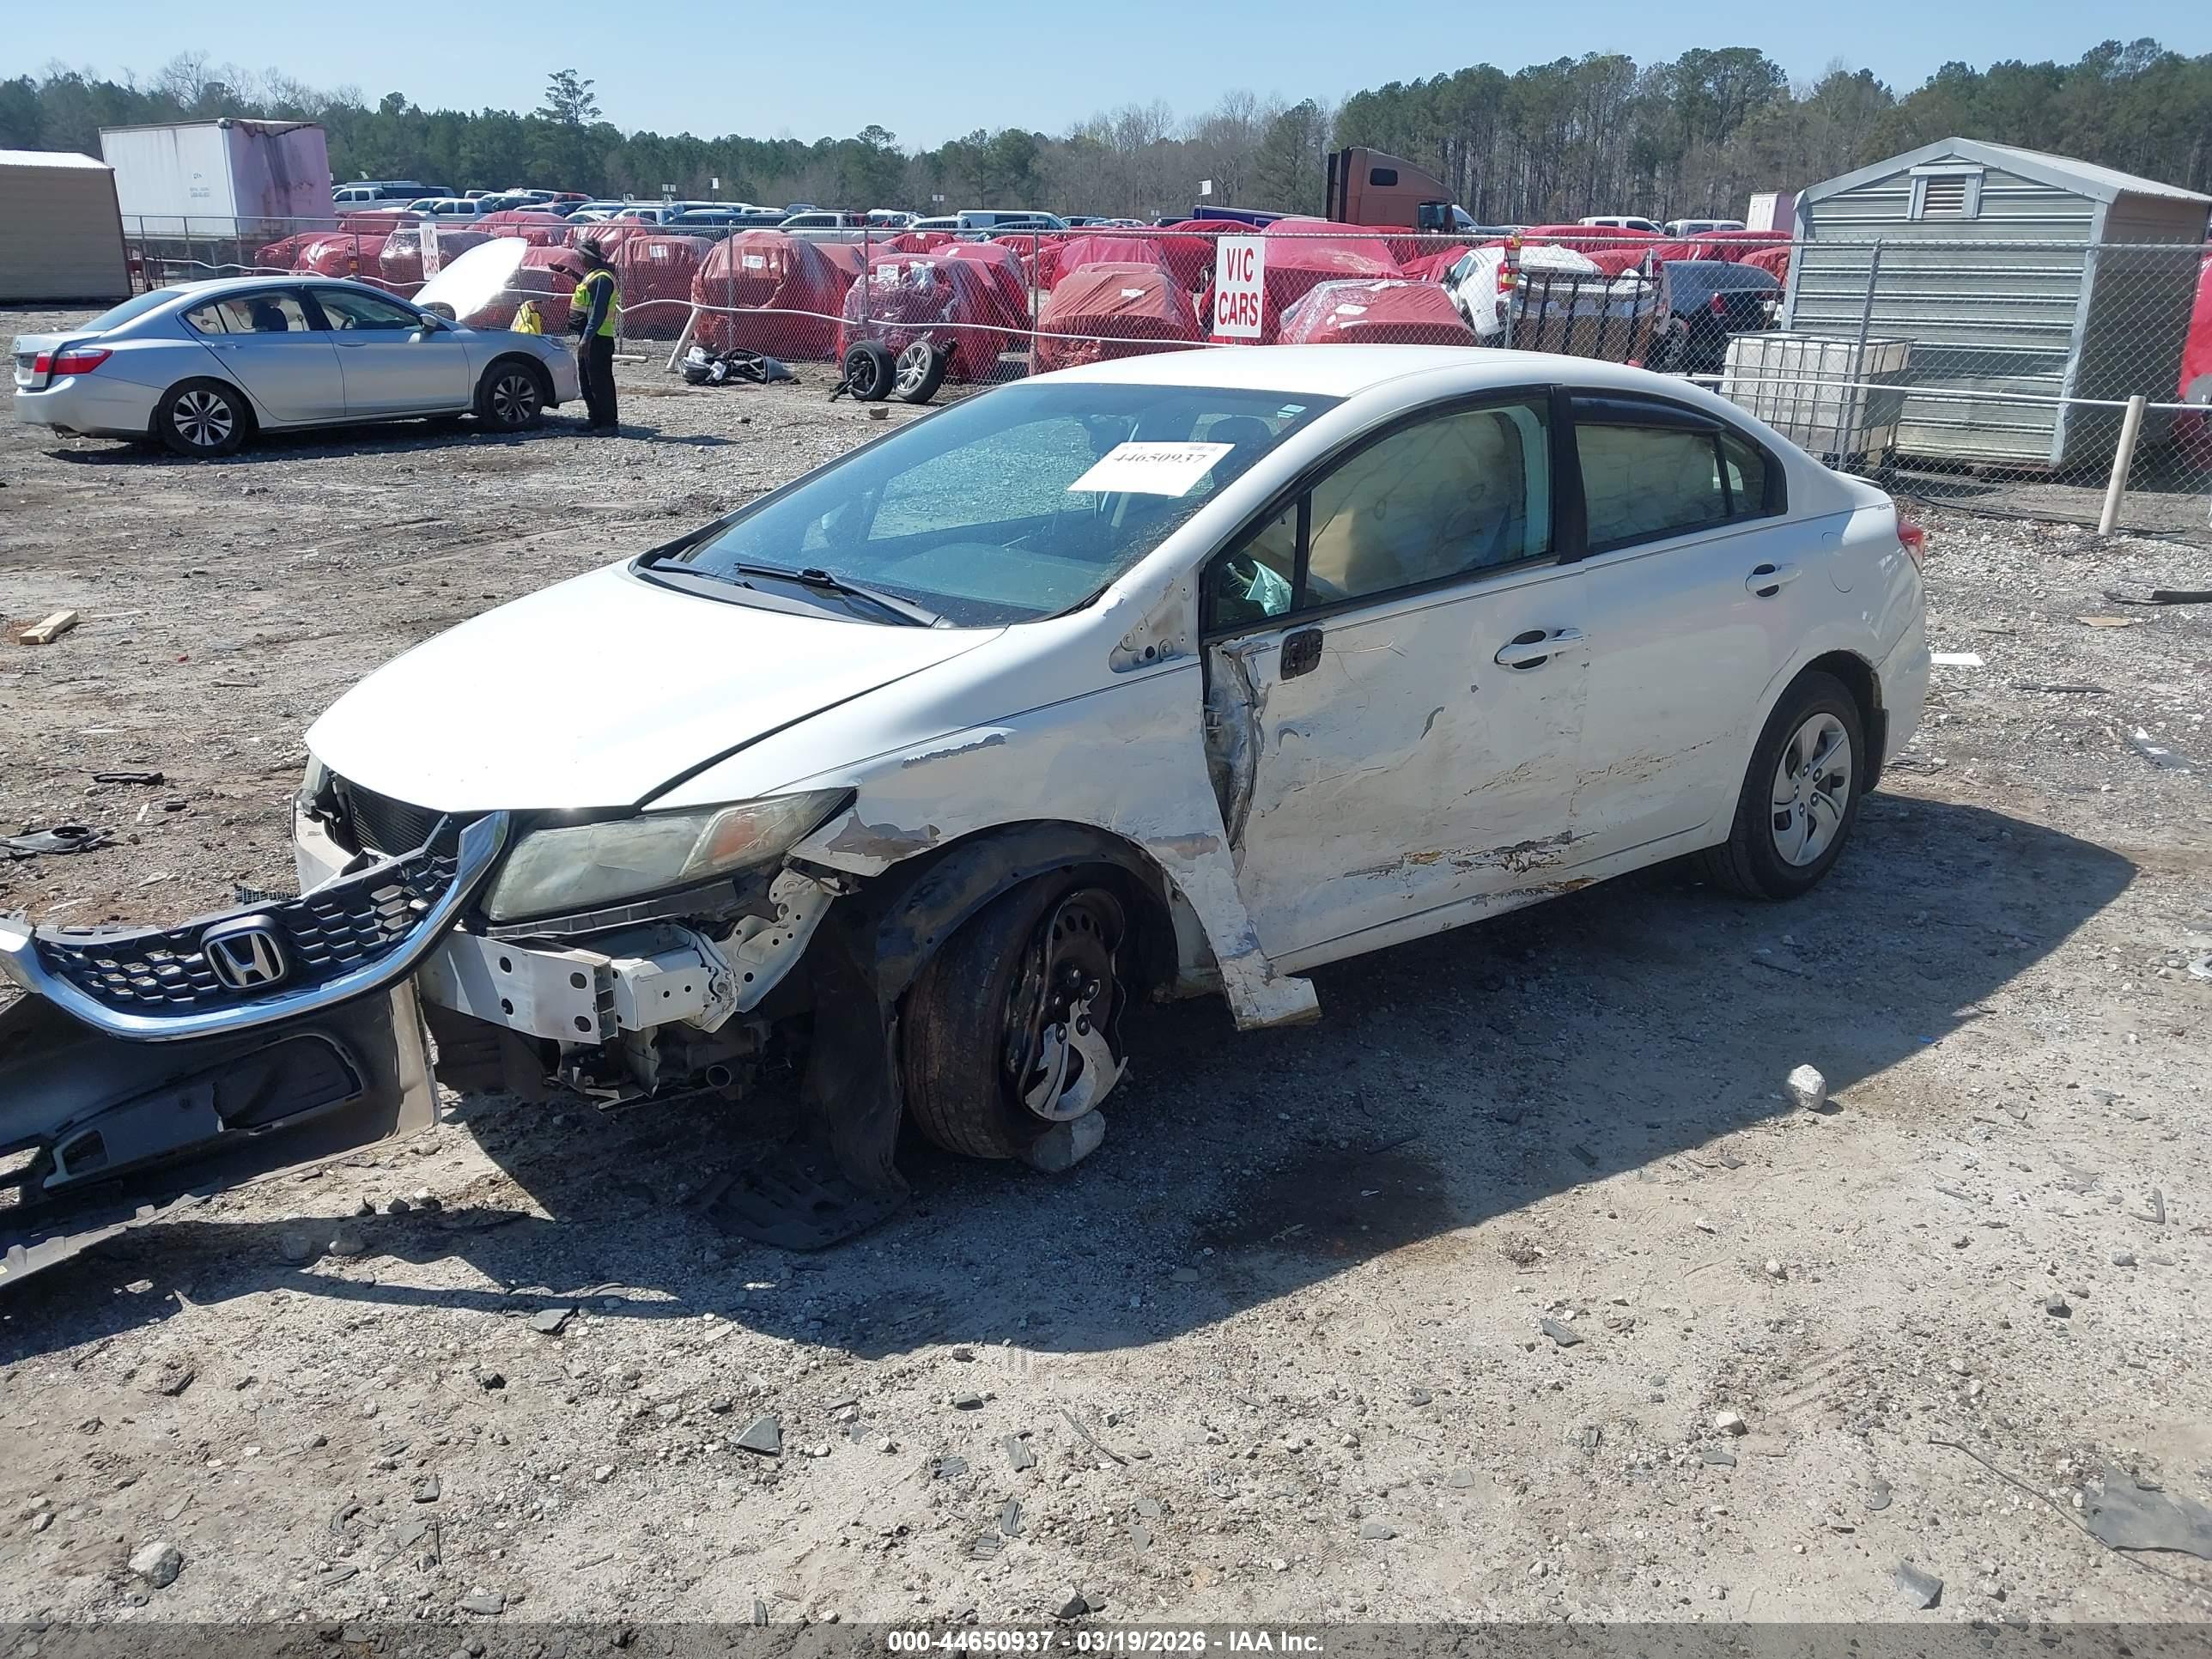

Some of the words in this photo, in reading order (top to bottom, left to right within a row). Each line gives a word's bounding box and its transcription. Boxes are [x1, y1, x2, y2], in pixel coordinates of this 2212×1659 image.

[422, 229, 434, 249] VIC
[424, 254, 438, 275] CARS
[1226, 247, 1255, 283] VIC
[1218, 291, 1259, 327] CARS
[1114, 452, 1208, 464] 44650937
